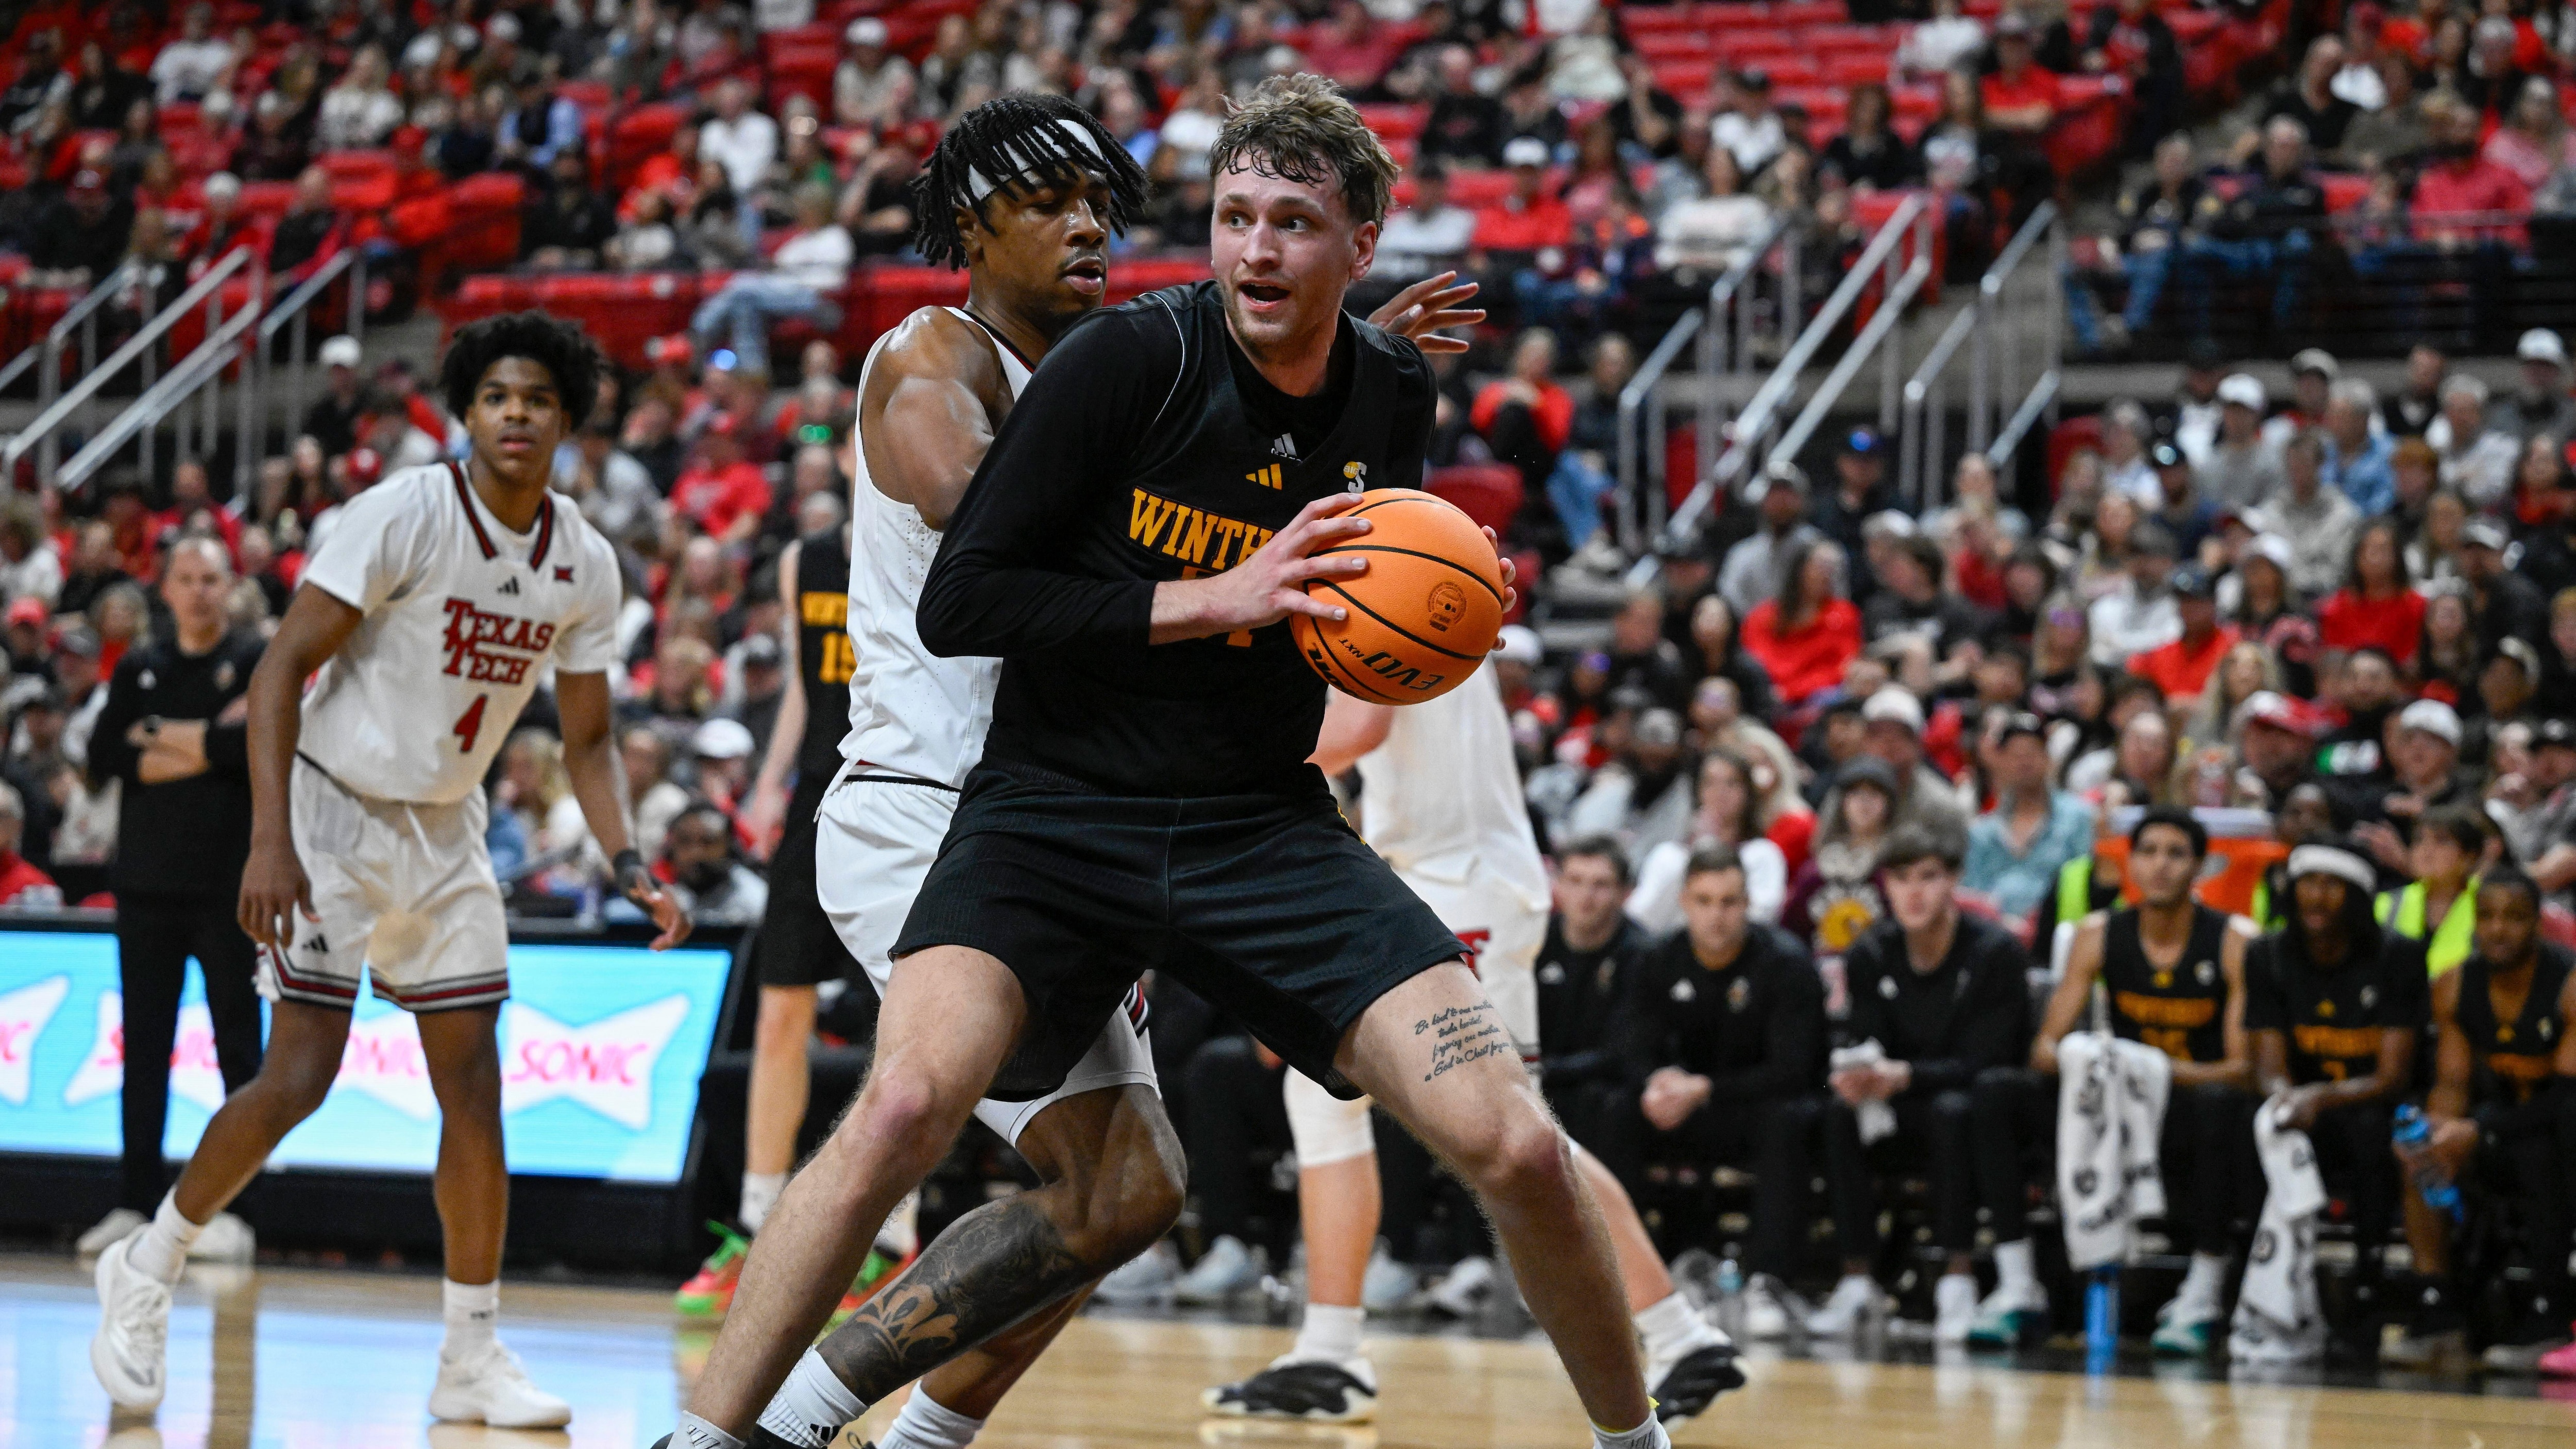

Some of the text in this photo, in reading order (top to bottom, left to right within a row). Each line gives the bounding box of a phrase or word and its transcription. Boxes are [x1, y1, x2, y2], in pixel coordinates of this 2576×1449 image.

[1129, 488, 1282, 570] WINTH
[444, 596, 556, 653] TEXAS
[444, 628, 532, 685] TECH
[1338, 638, 1365, 659] NXT
[1362, 651, 1445, 690] EVO
[453, 693, 488, 753] 4
[1415, 1020, 1429, 1035] Be
[1432, 1008, 1449, 1025] kind
[1450, 1008, 1458, 1017] to
[339, 1032, 422, 1078] ONIC
[509, 1038, 648, 1086] SONIC
[1434, 1055, 1454, 1076] God
